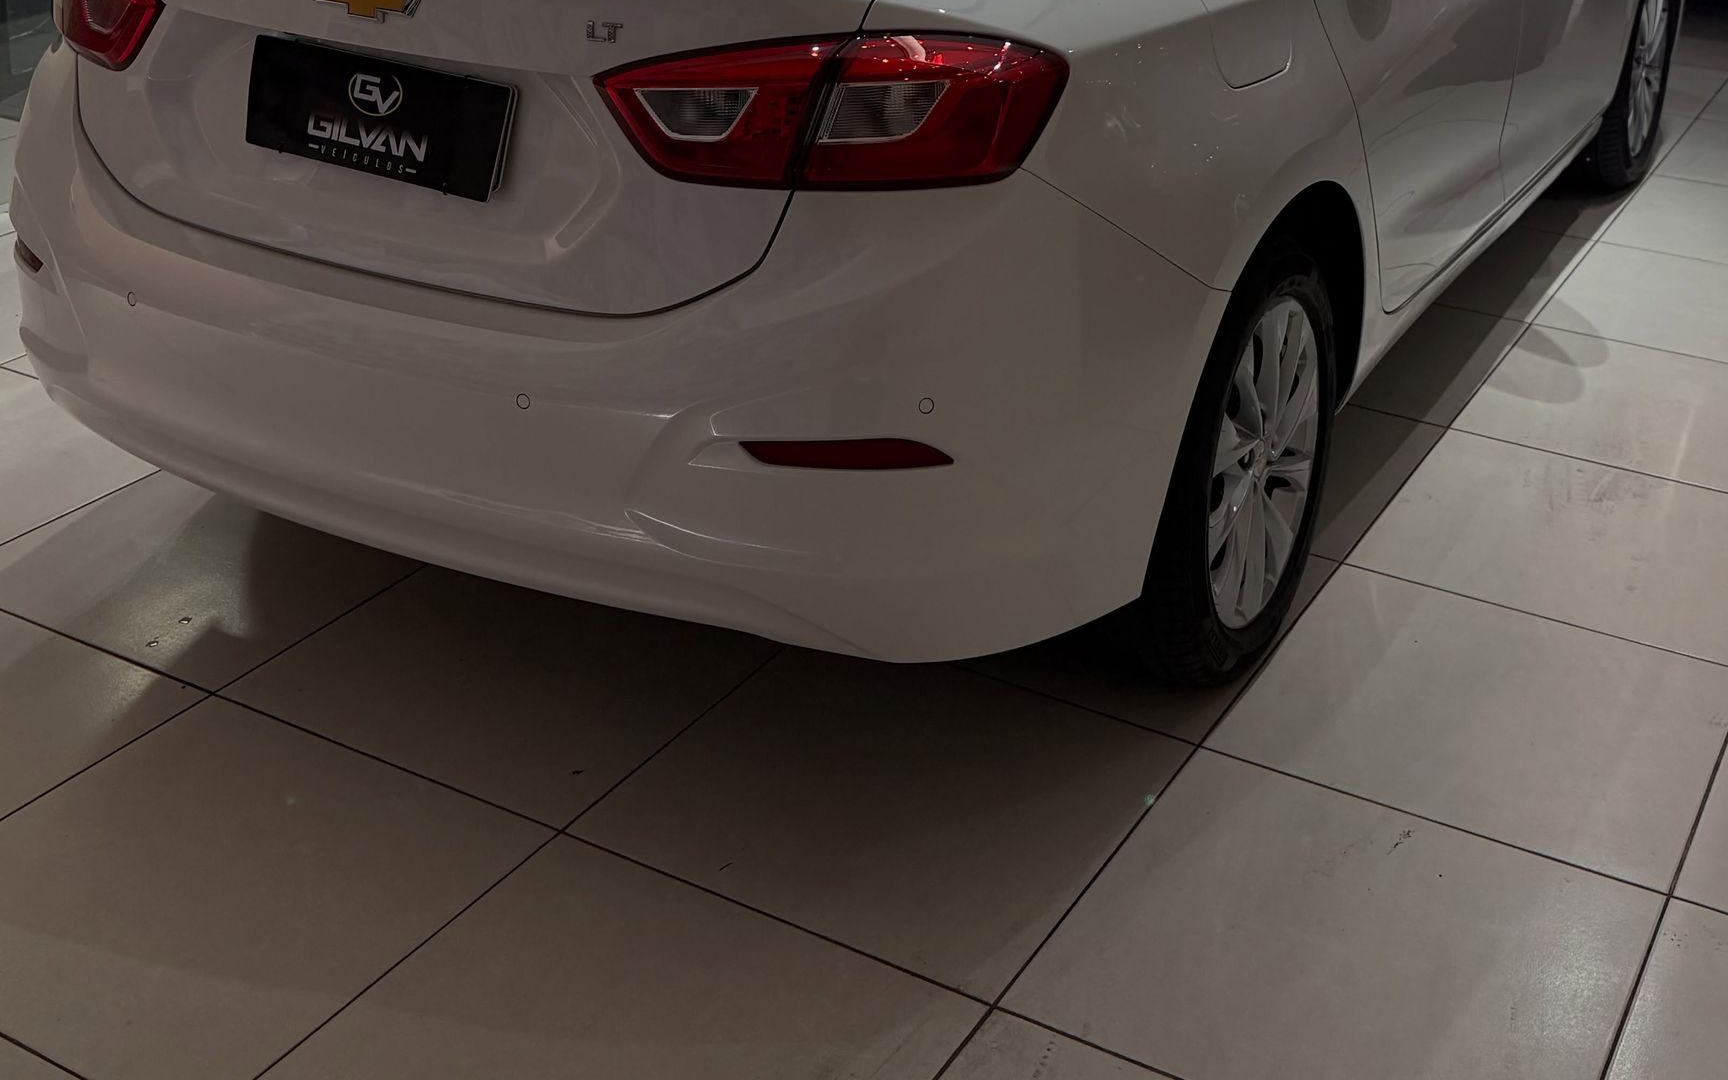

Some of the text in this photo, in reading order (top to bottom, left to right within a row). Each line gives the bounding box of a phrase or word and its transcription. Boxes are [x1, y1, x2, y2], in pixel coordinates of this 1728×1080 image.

[586, 20, 623, 43] LT
[353, 74, 400, 114] GV
[307, 111, 429, 162] GILVAN
